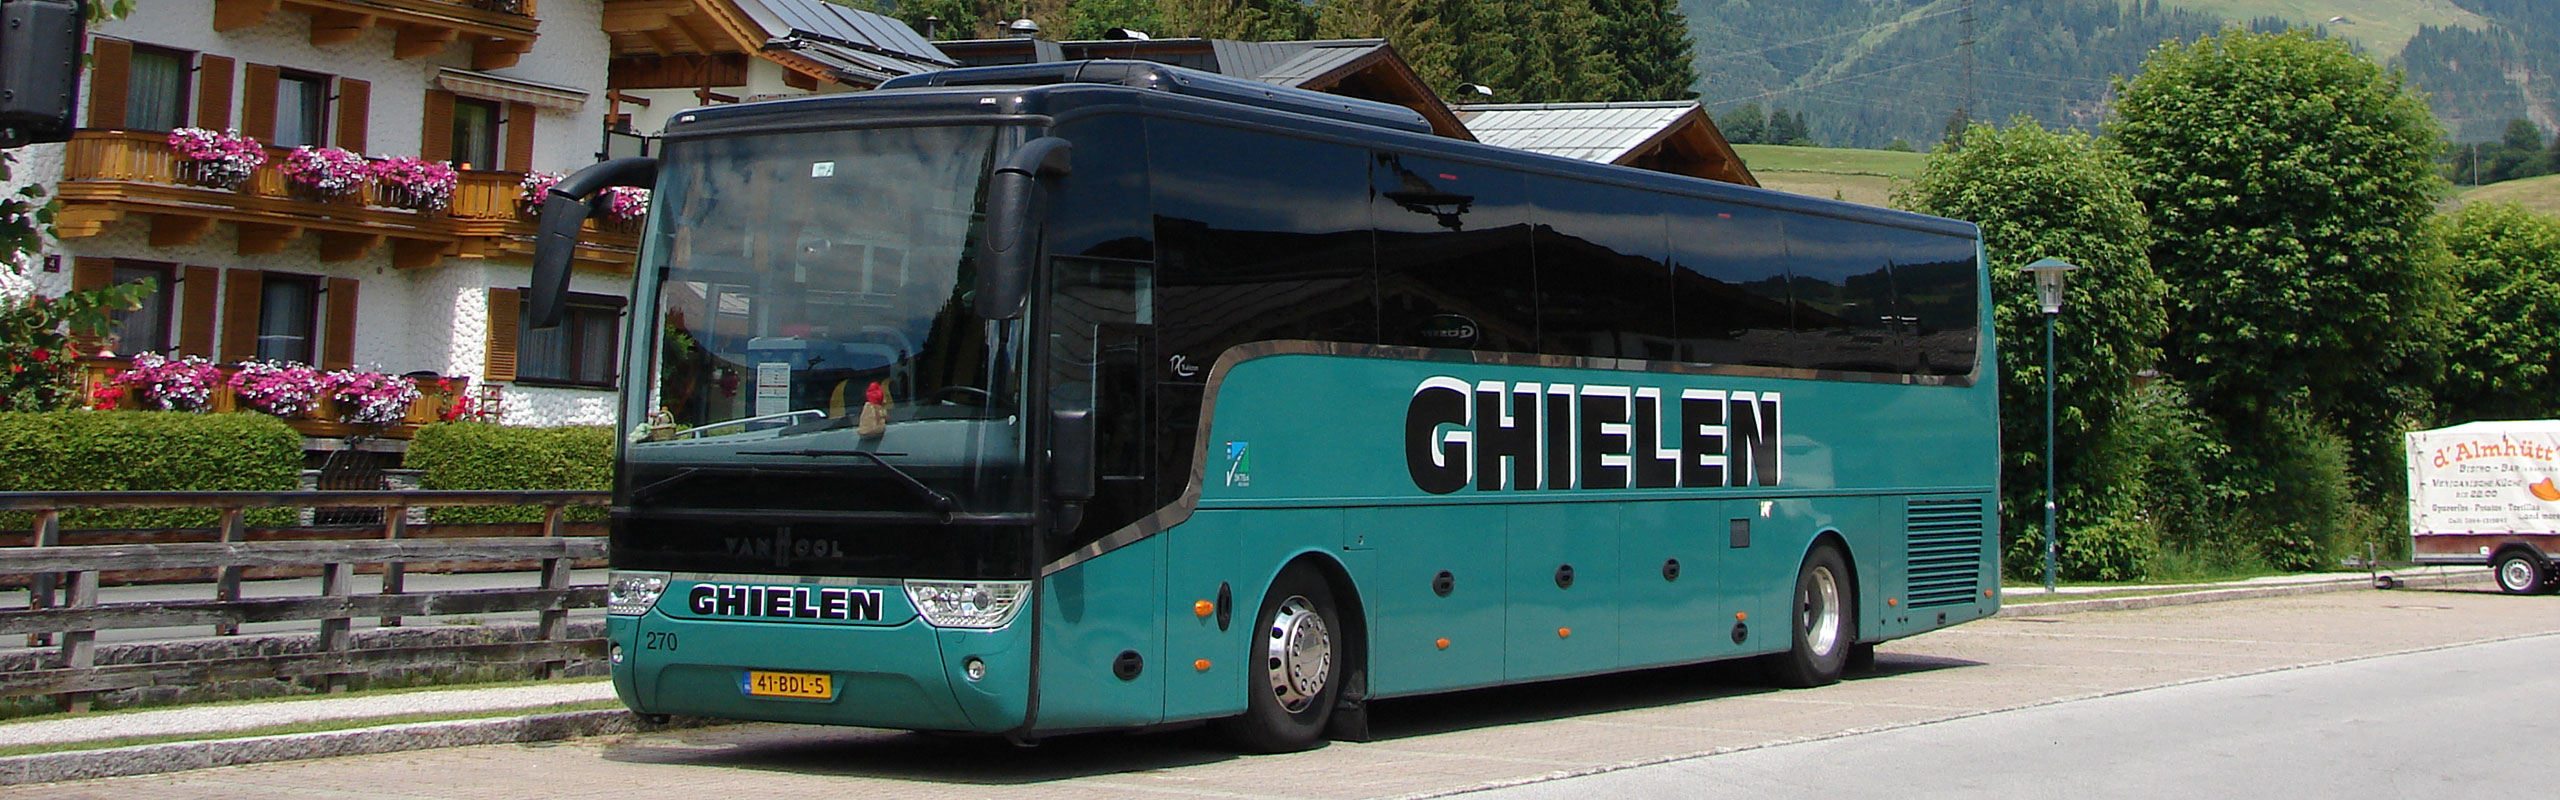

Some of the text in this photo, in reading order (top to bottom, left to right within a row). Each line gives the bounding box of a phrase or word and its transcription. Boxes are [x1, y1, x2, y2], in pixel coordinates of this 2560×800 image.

[1405, 376, 1782, 494] GHIELEN
[689, 583, 884, 621] GHIELEN
[646, 631, 678, 651] 270
[757, 675, 824, 694] 41-BDL-5
